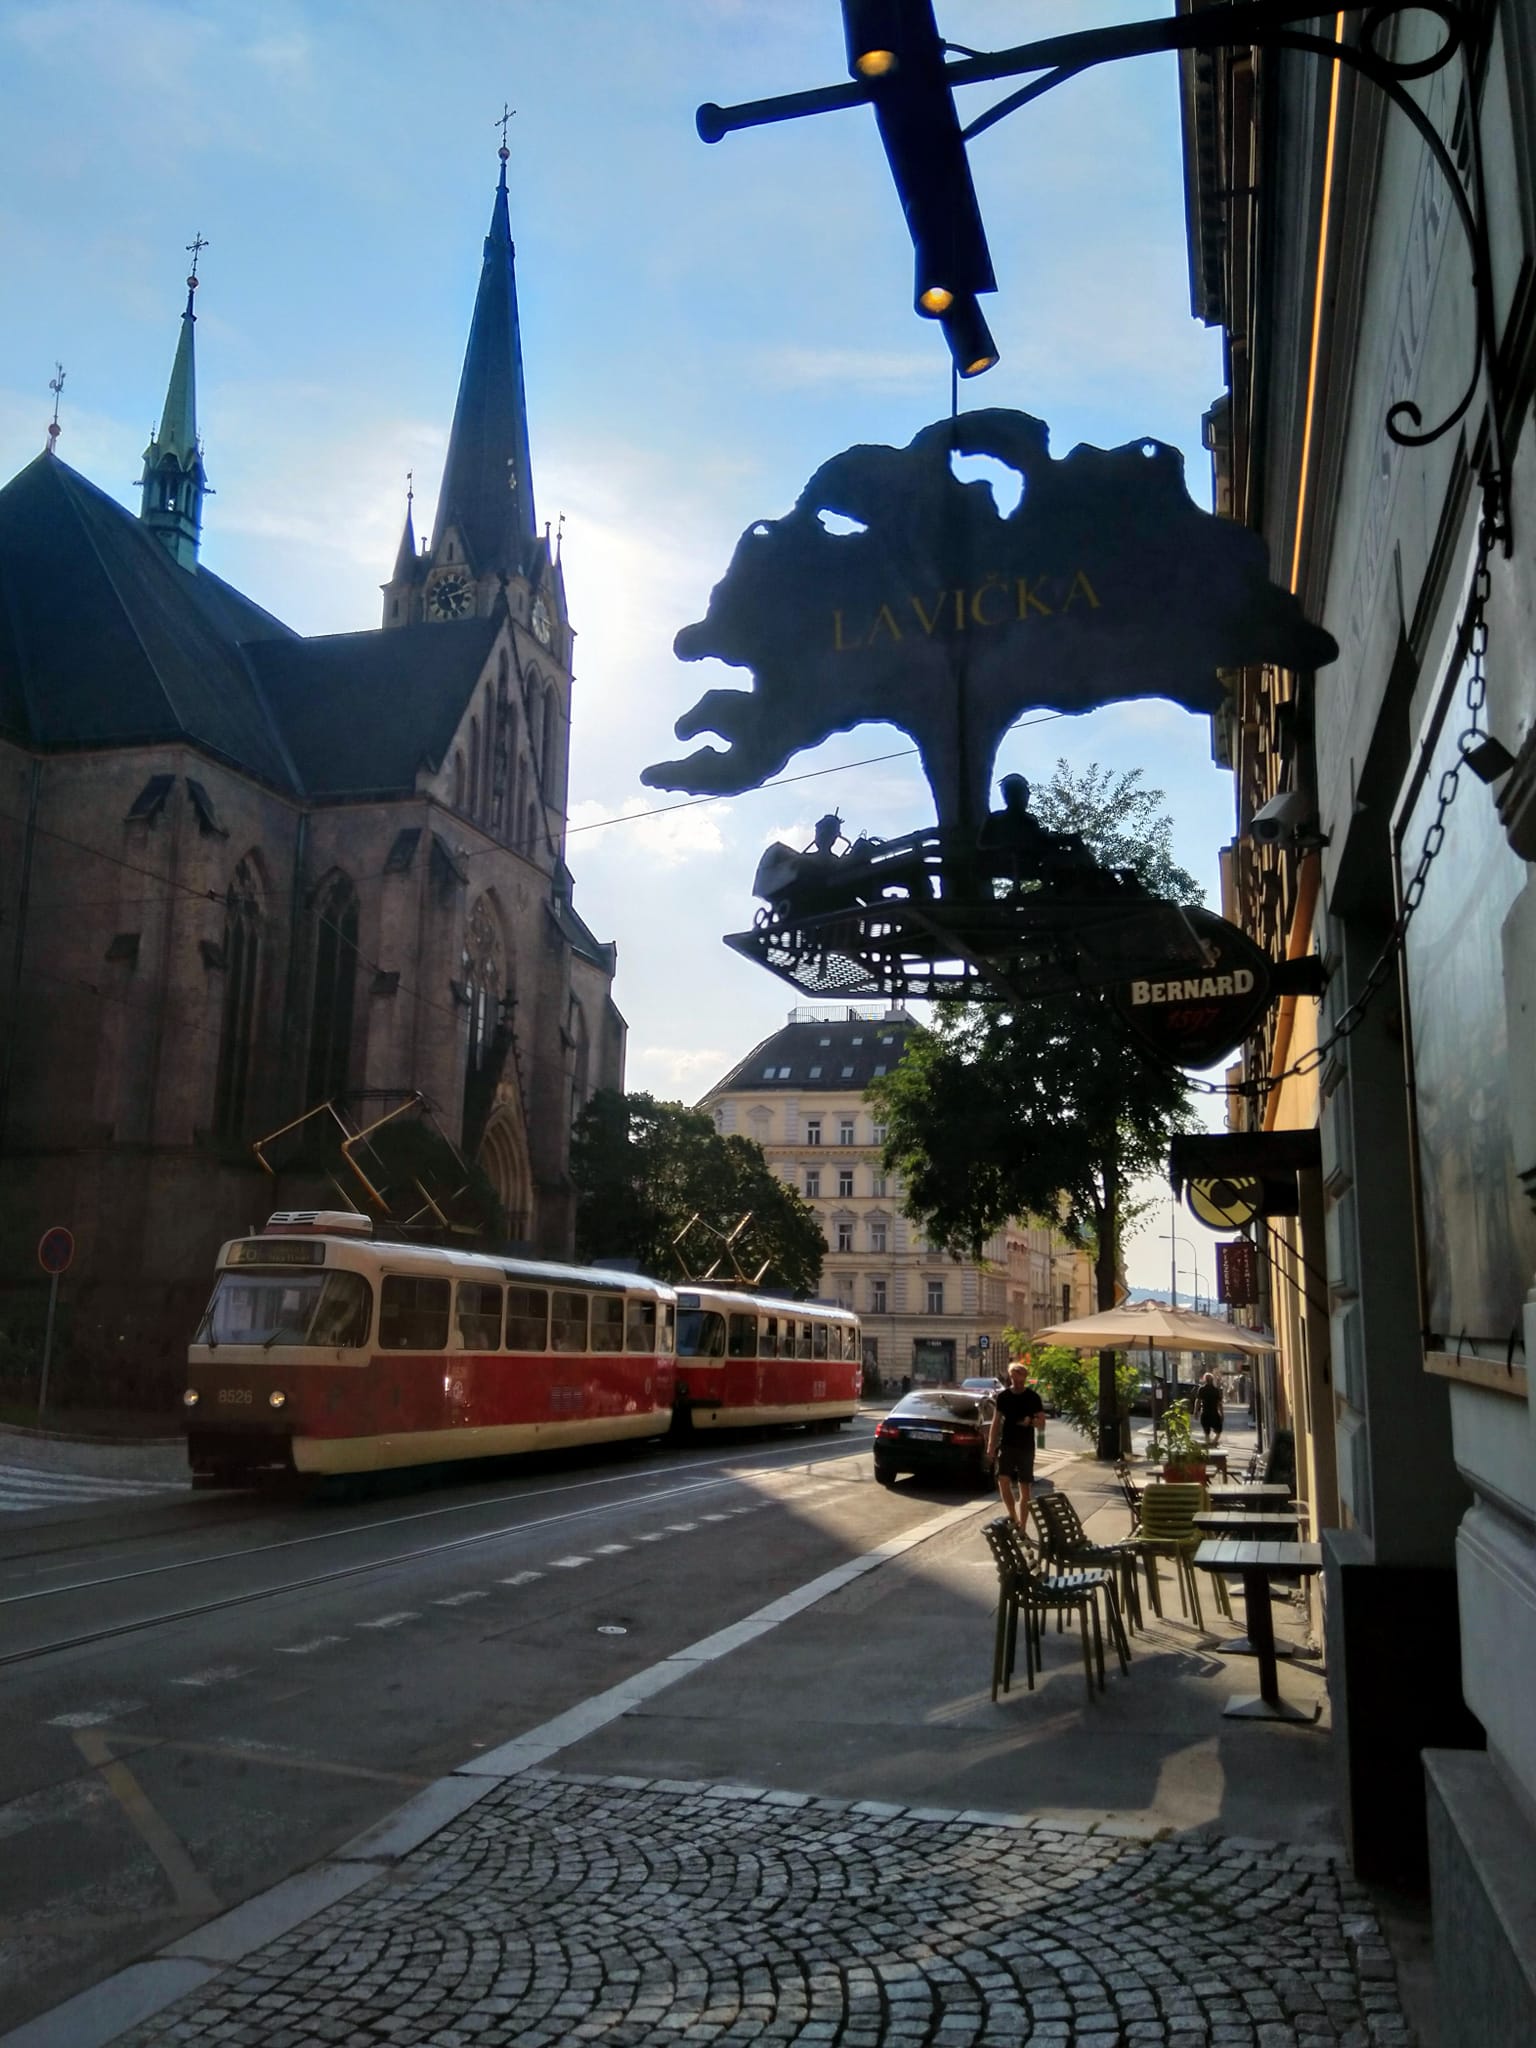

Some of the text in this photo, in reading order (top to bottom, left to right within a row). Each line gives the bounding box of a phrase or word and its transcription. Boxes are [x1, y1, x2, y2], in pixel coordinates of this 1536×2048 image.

[832, 569, 1102, 651] LAVIČKA
[1131, 969, 1254, 1005] BERNARD
[1222, 1247, 1232, 1298] PIZZERIA
[218, 1389, 253, 1404] 8526
